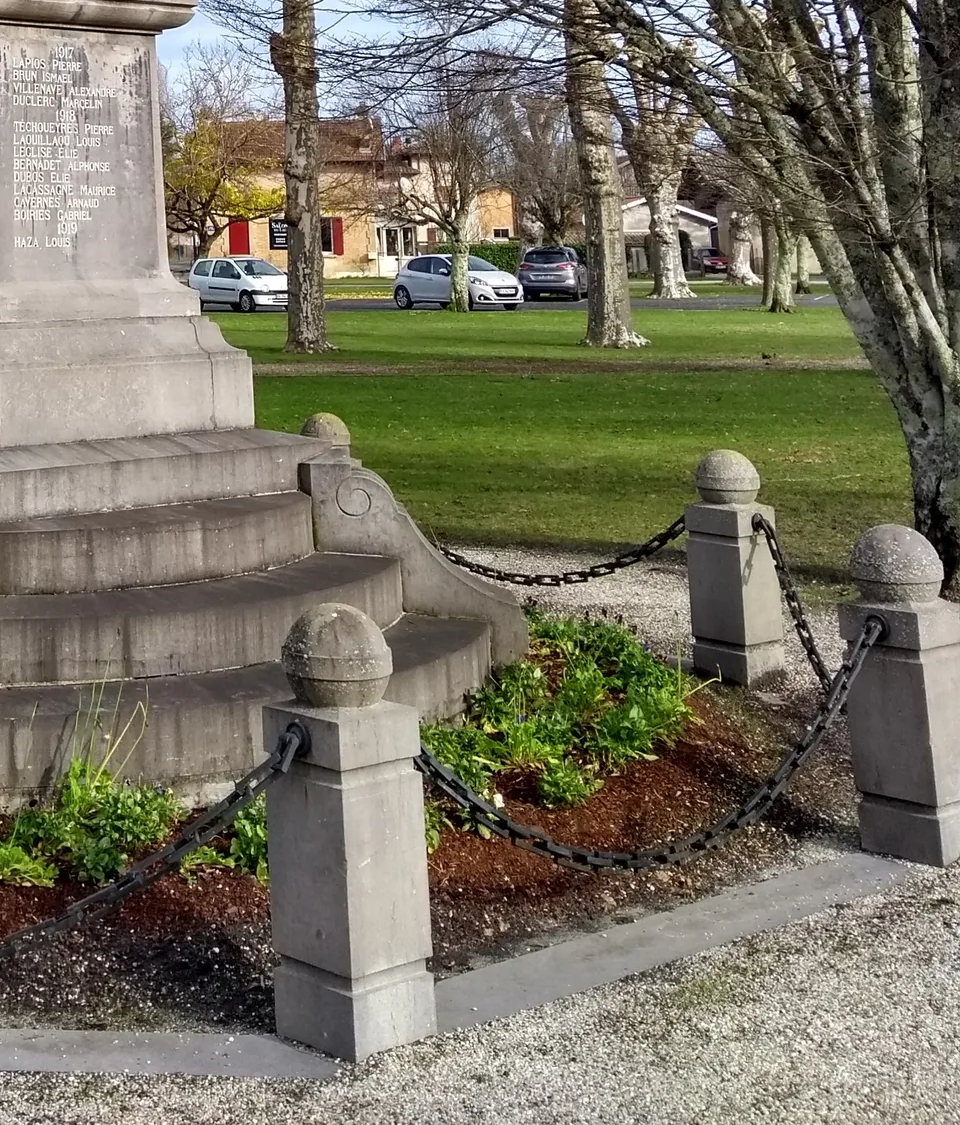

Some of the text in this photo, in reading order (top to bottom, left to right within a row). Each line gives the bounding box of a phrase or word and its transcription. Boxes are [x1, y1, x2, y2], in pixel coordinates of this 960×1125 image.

[55, 46, 74, 59] 1917
[13, 57, 82, 72] LAPIOS PIERRE
[13, 70, 73, 83] BRUN ISMAEL
[13, 82, 117, 97] VILLENAVE ALEXANDRE
[13, 95, 103, 109] DUCLERC MARCELIN
[55, 109, 76, 122] 1918
[84, 123, 114, 135] PIERRE
[76, 136, 101, 147] LOUIS
[13, 159, 110, 172] BERNADET ALPHONSE
[13, 171, 71, 183] DUBOS ELIE
[14, 184, 116, 196] LACASSAGNE MAURICE
[14, 197, 100, 208] CAVERNES ARNAUD
[14, 209, 93, 221] BOIRIES GABRIEL
[57, 222, 78, 235] 1919
[14, 236, 71, 248] HAZA LOUIS
